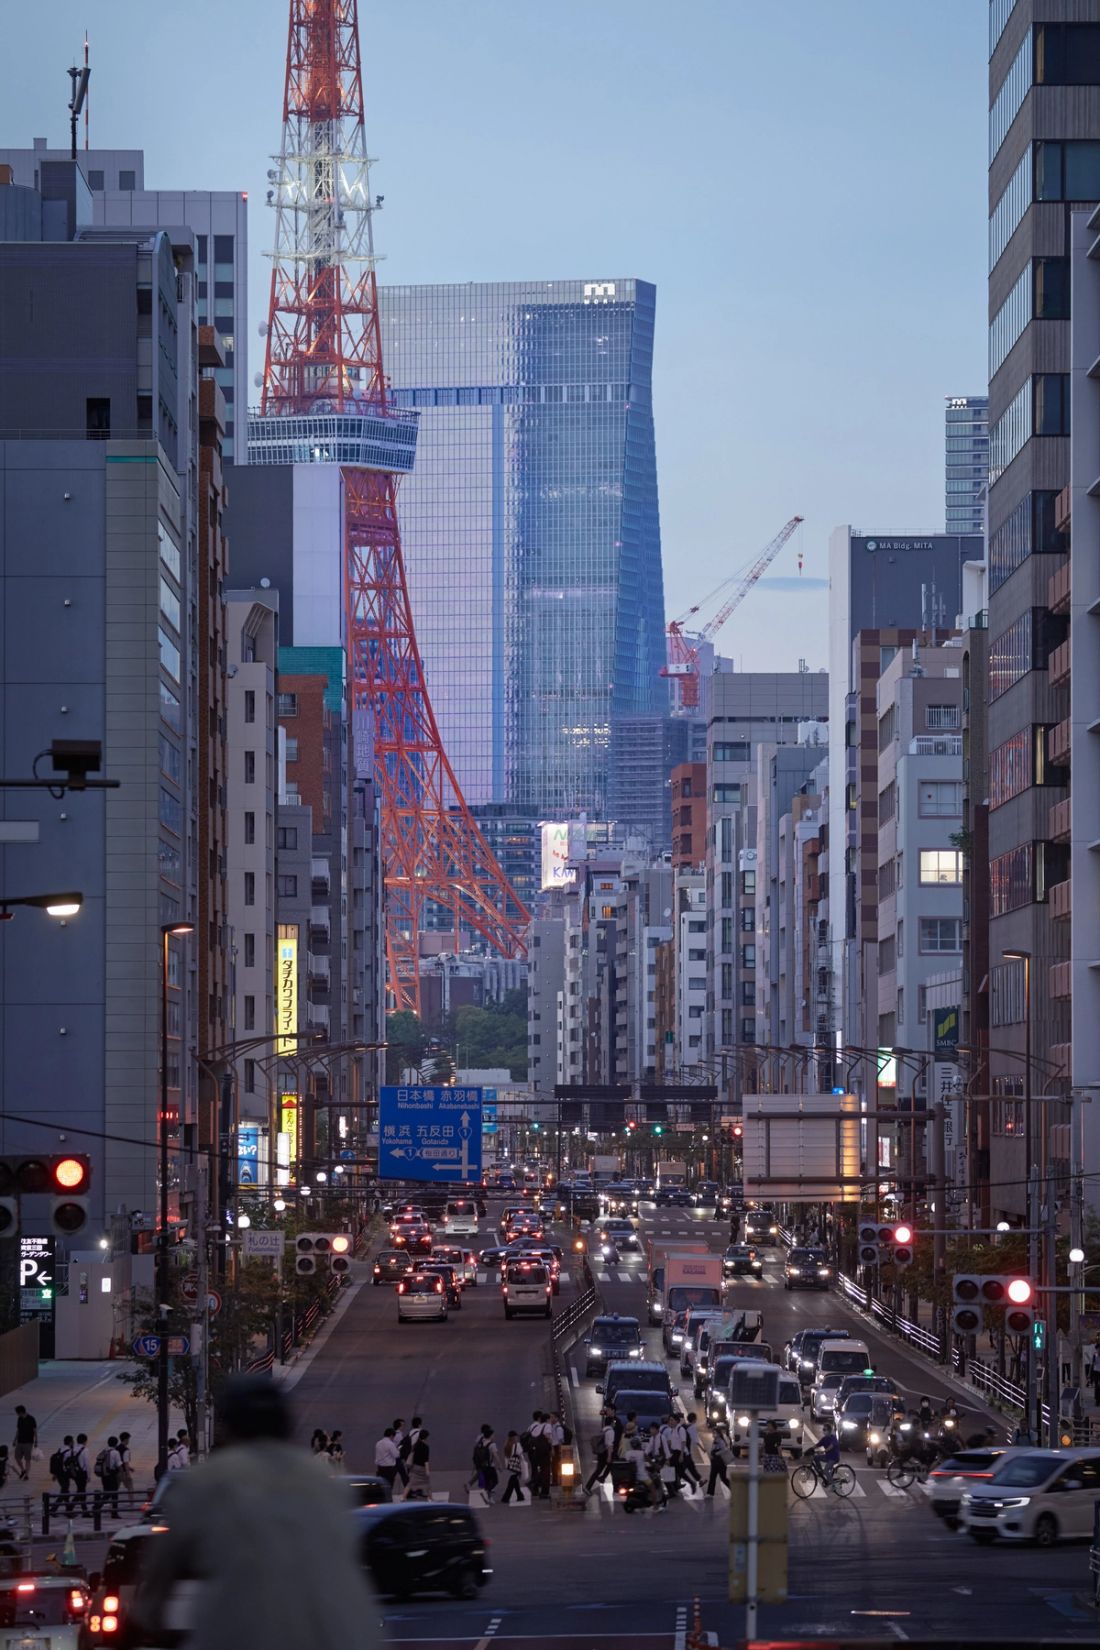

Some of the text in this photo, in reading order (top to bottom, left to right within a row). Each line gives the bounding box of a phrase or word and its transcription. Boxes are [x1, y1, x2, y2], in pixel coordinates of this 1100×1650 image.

[893, 542, 912, 550] Bldg.
[397, 1090, 478, 1102] 日本橋 赤羽橋
[383, 1125, 454, 1137] 横浜 五反田
[248, 1235, 280, 1246] 札の辻
[20, 1259, 38, 1286] P
[145, 1340, 157, 1352] 15
